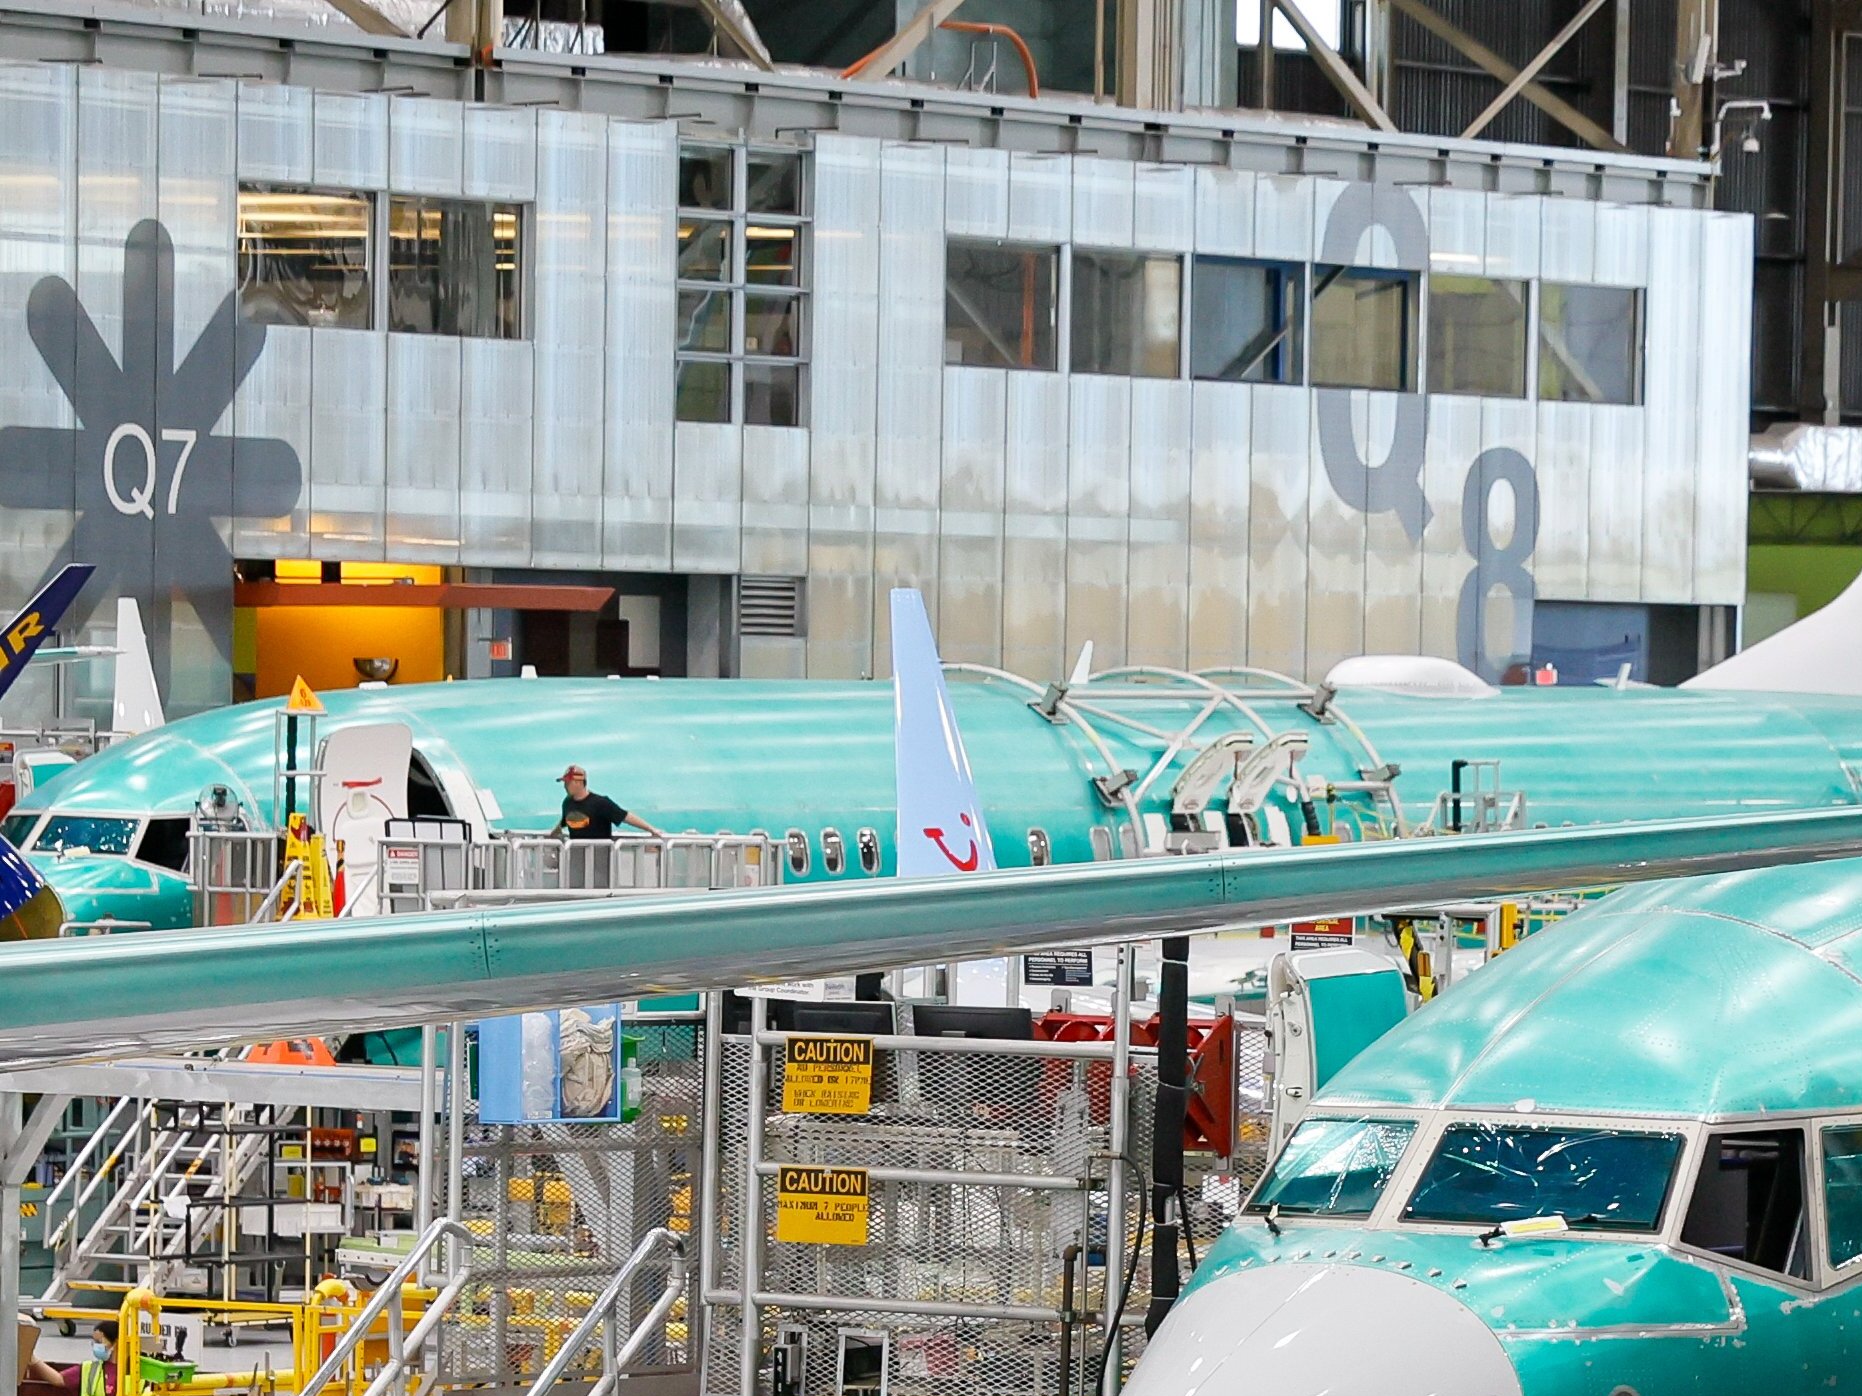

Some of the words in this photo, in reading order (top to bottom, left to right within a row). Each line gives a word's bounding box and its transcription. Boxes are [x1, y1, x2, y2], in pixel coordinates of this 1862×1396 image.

[104, 423, 197, 520] Q7
[794, 1041, 865, 1062] CAUTION
[785, 1171, 862, 1194] CAUTION
